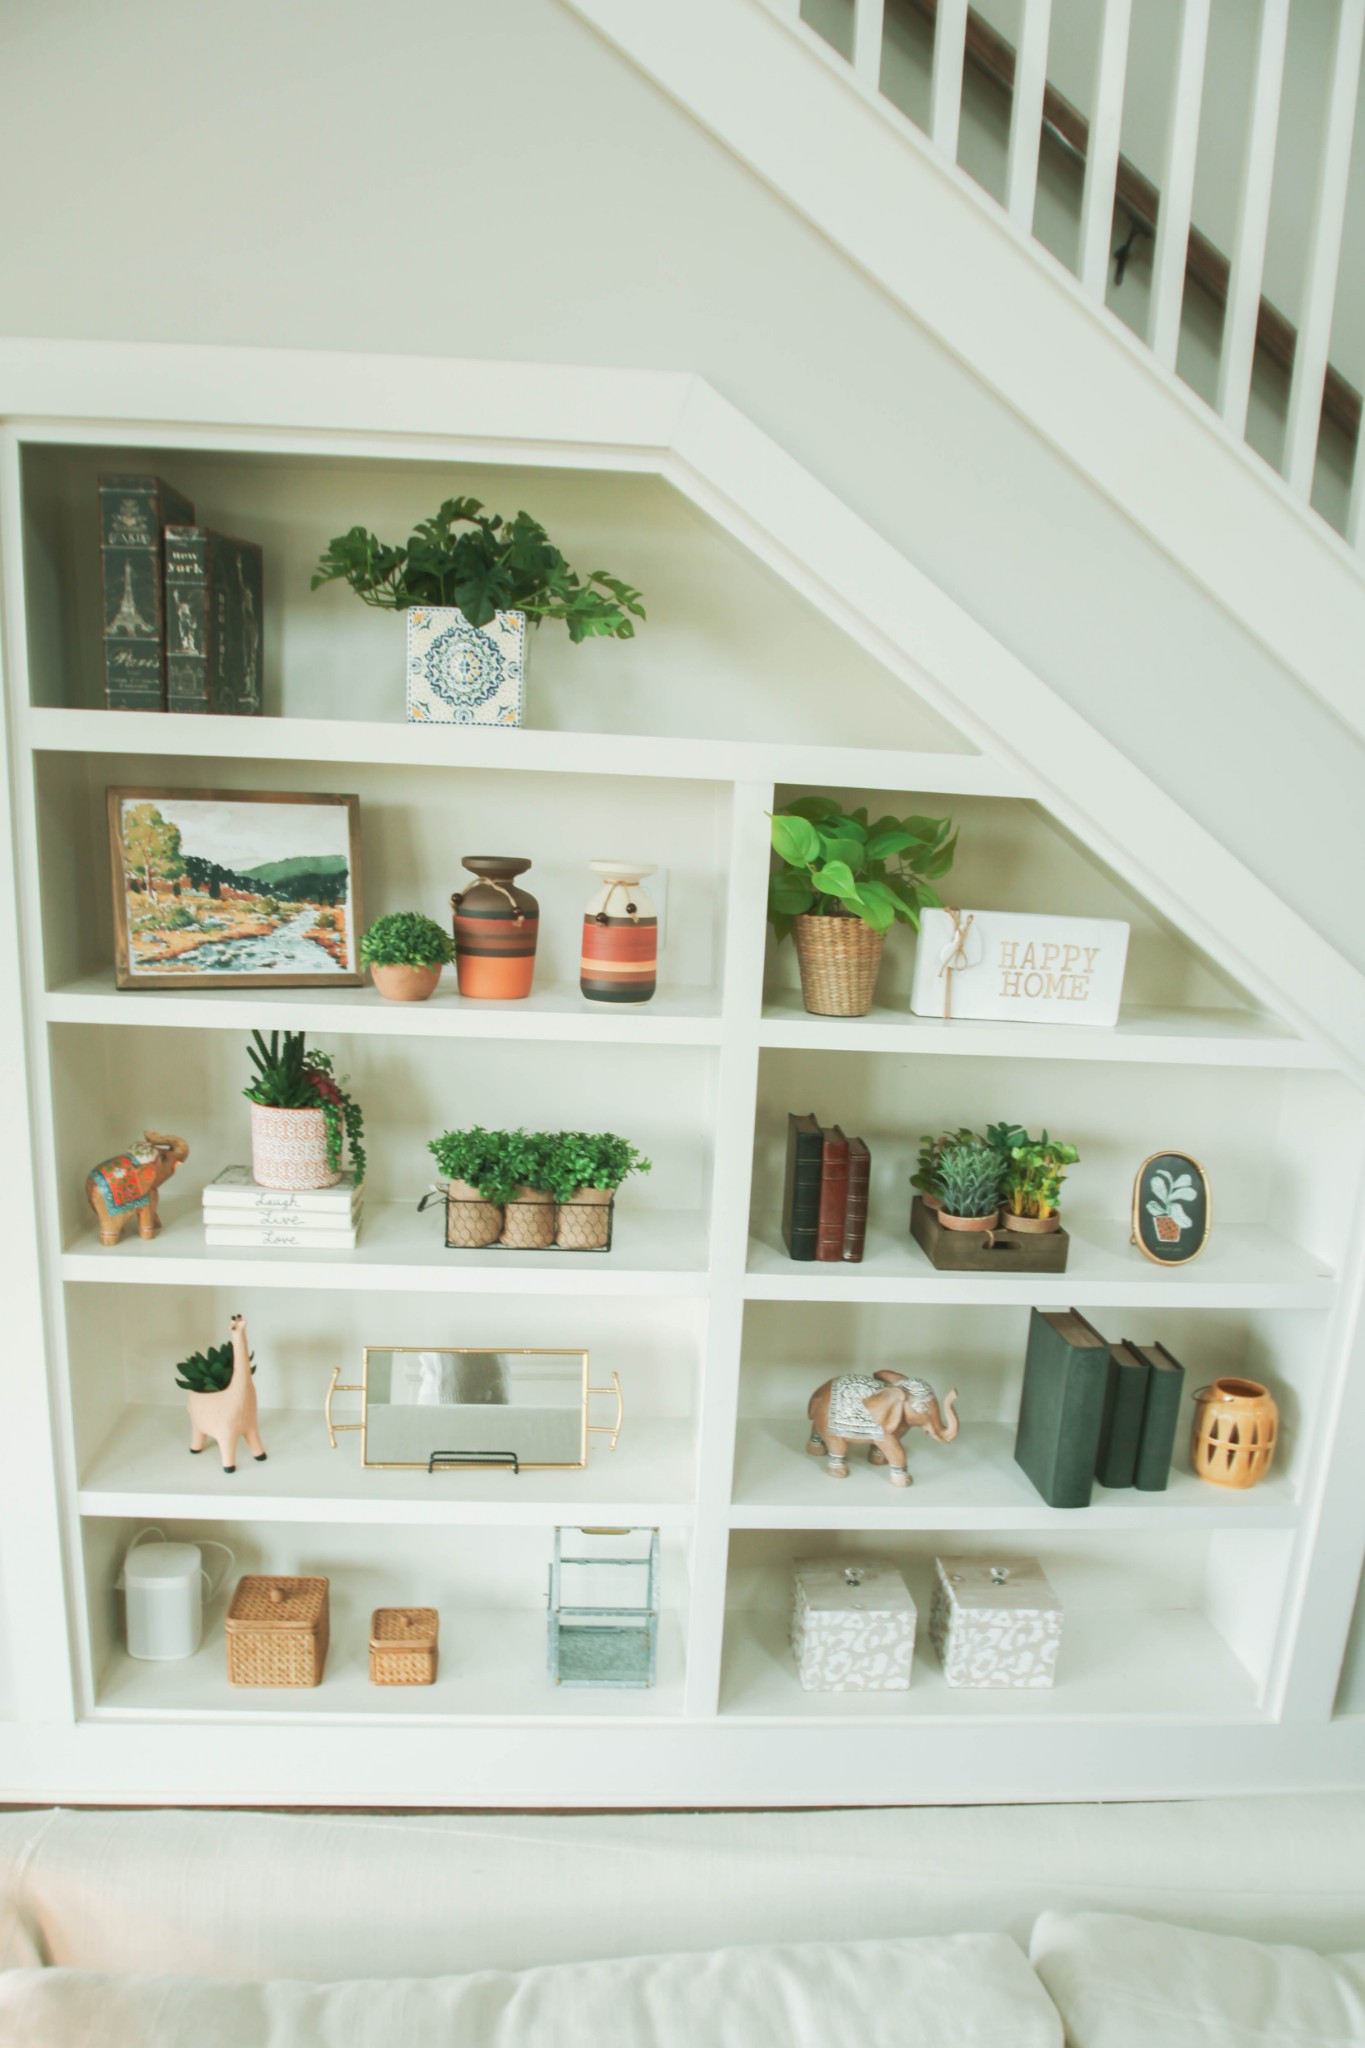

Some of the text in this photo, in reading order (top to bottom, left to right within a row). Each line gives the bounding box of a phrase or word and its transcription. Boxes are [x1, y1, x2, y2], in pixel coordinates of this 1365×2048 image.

[998, 941, 1101, 974] HAPPY
[998, 971, 1090, 1001] HOME
[254, 1192, 301, 1210] Laugh
[257, 1210, 305, 1226] Live
[261, 1229, 301, 1245] Love
